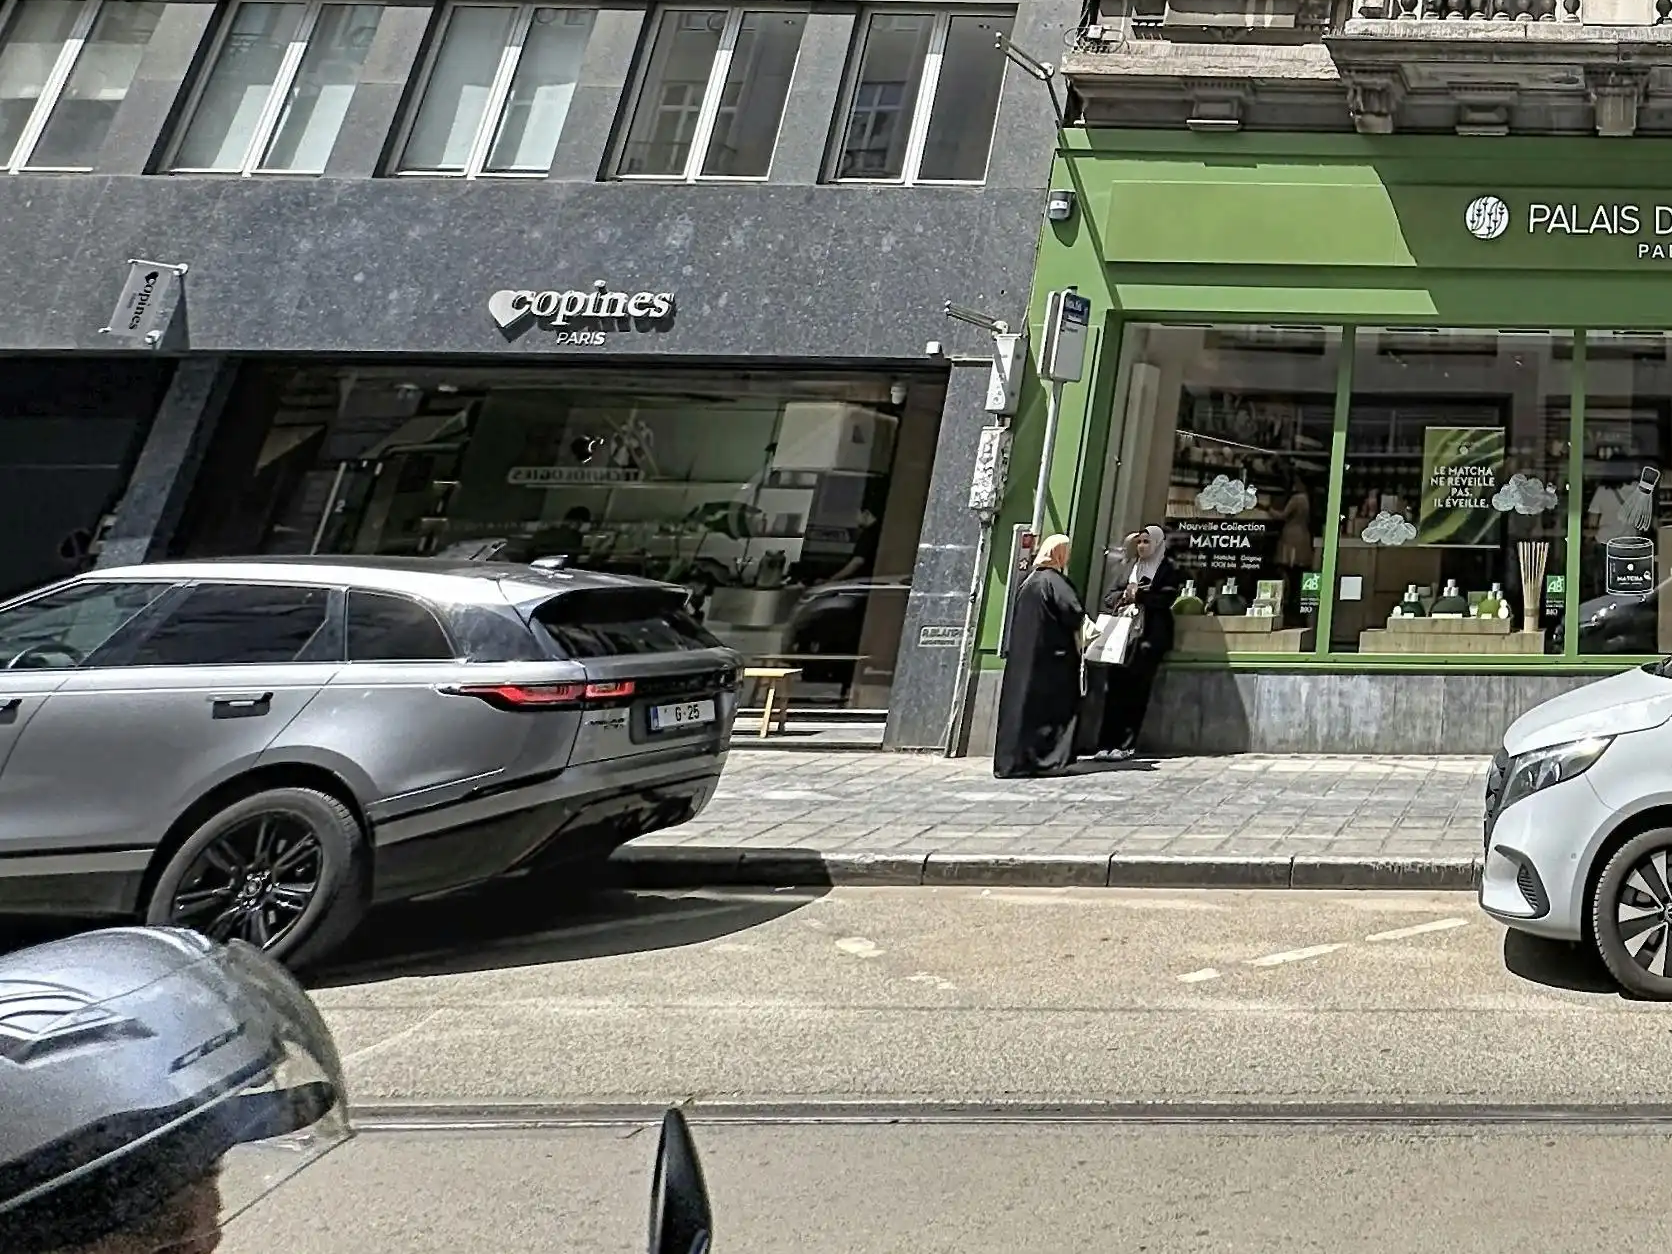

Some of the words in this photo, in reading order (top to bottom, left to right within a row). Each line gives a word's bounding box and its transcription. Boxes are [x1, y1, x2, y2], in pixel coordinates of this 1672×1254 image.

[1528, 204, 1640, 234] PALAIS
[129, 277, 156, 330] copines
[511, 280, 675, 325] copines
[556, 331, 607, 345] PARIS
[1434, 466, 1446, 475] LE
[1448, 466, 1493, 476] MATCHA
[1430, 477, 1445, 486] NE
[1451, 487, 1473, 497] PAS.
[1434, 498, 1443, 508] IL
[1445, 496, 1489, 508] ÉVEILLE.
[1179, 522, 1219, 531] Nouvelle
[1220, 522, 1266, 531] Collection
[1189, 534, 1251, 548] MATCHA
